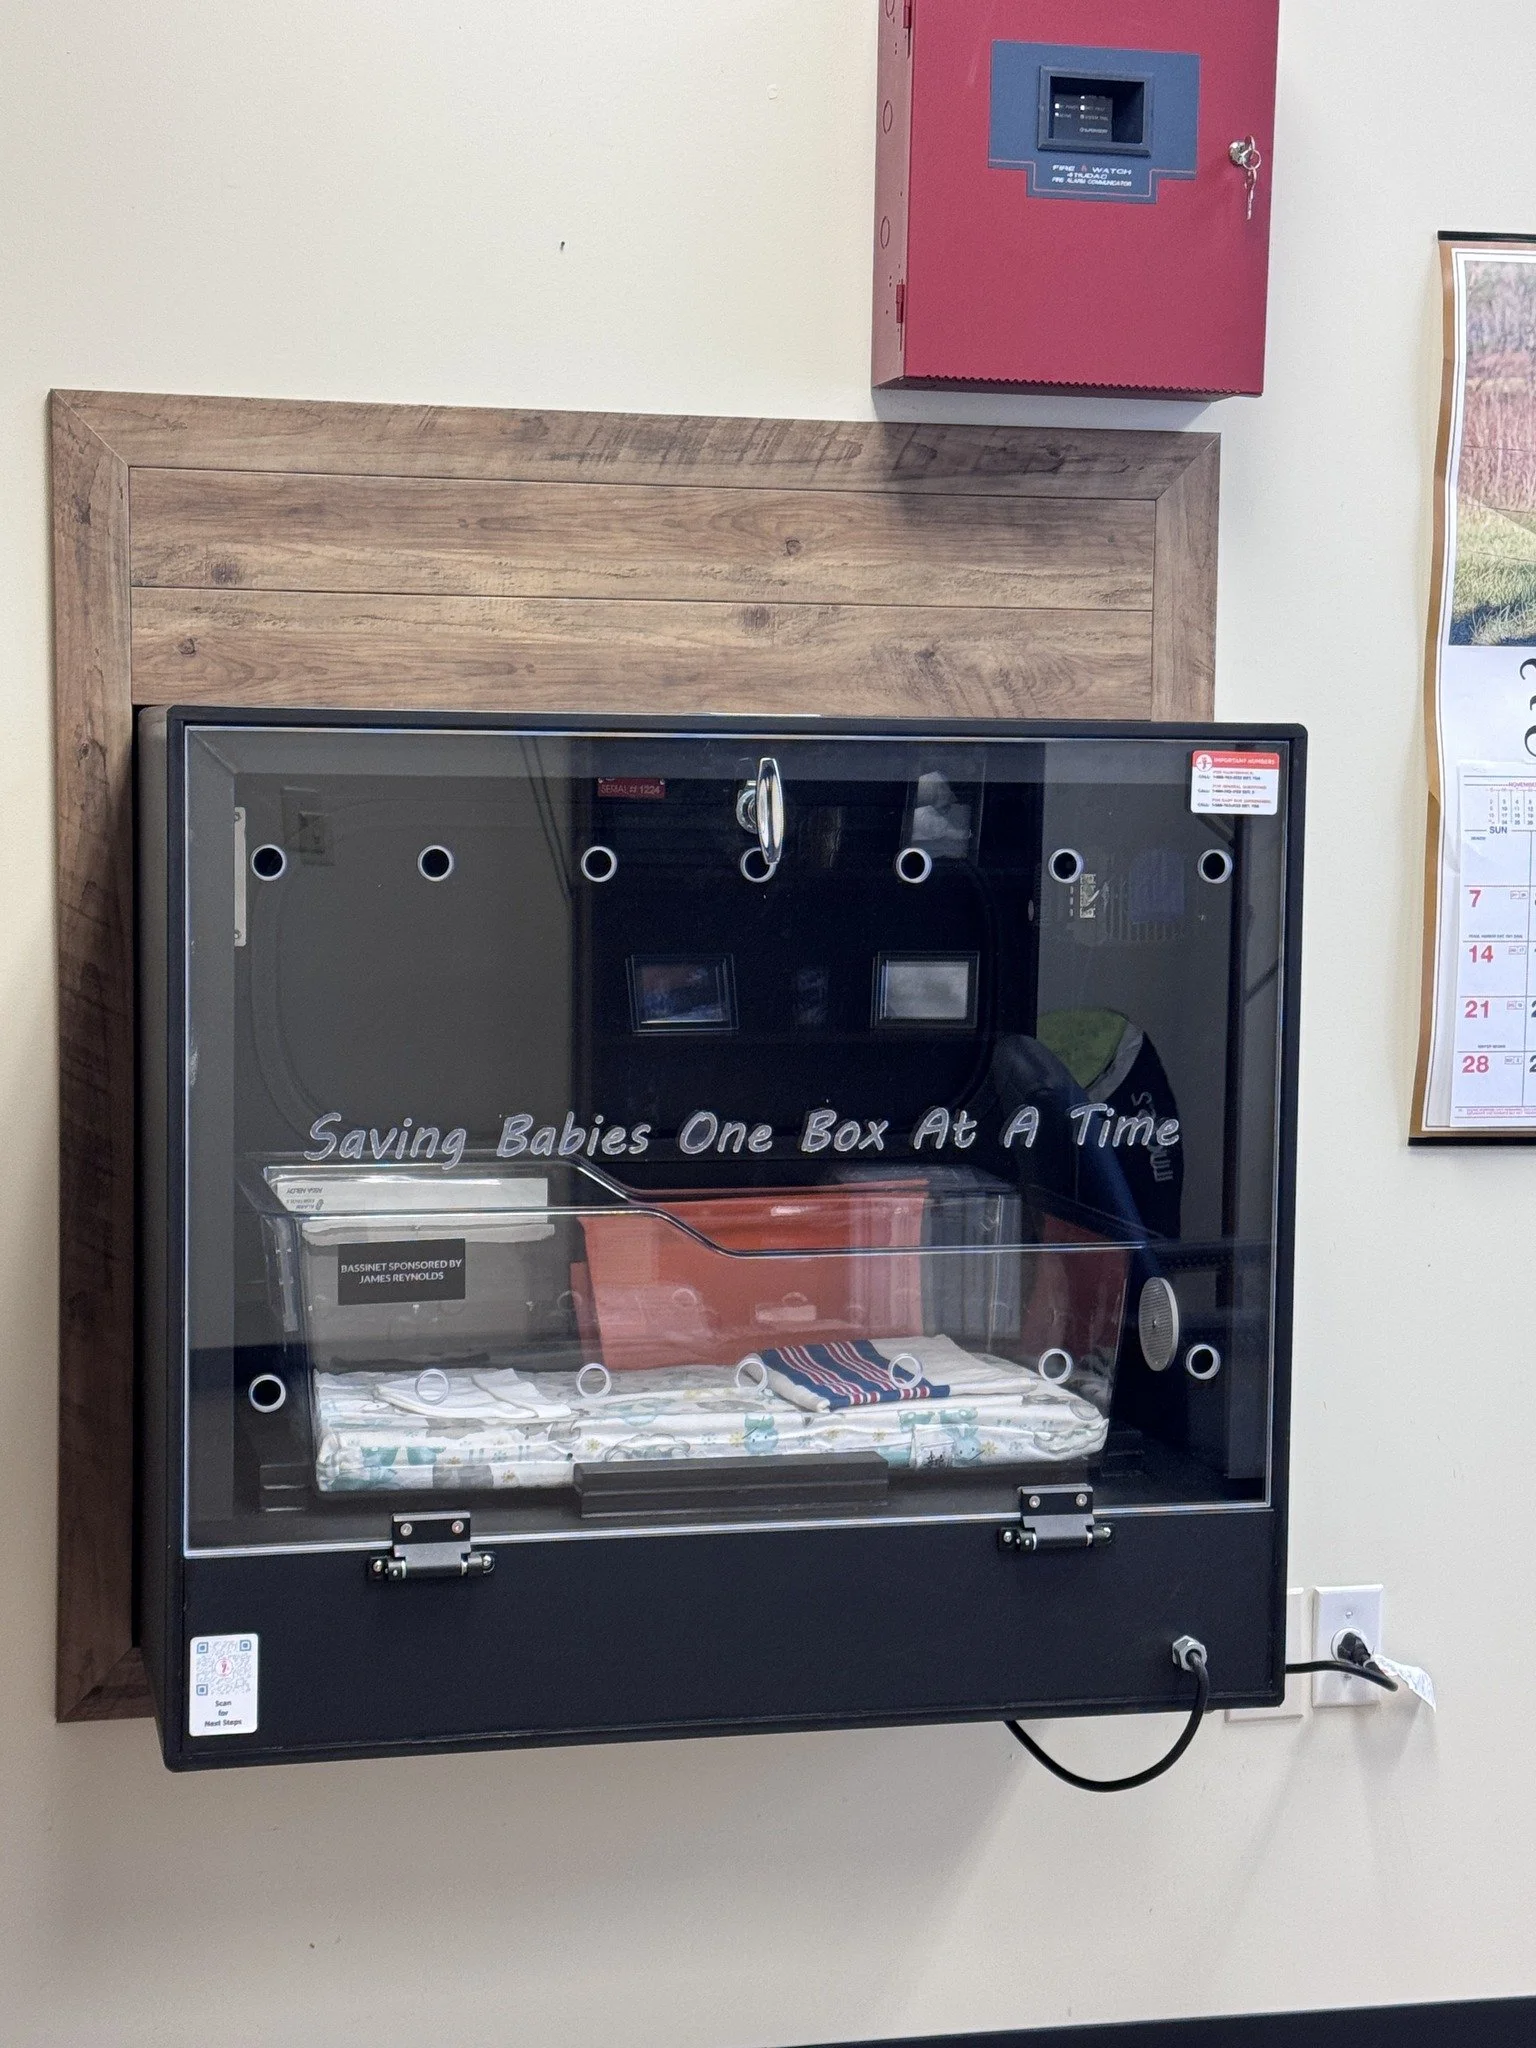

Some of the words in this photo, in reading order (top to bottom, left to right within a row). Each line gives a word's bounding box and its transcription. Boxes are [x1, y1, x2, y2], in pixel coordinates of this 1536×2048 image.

[1052, 164, 1075, 172] FIRE
[1092, 166, 1132, 175] WATCH
[600, 784, 627, 794] SERIAL
[640, 785, 660, 794] 1224
[1489, 826, 1508, 834] SUN
[1468, 889, 1482, 908] 7
[1469, 944, 1493, 963] 14
[1464, 1000, 1489, 1018] 21
[1462, 1055, 1489, 1074] 28
[303, 1112, 467, 1171] Saving
[497, 1111, 652, 1158] Babies
[678, 1110, 773, 1155] One
[800, 1108, 889, 1153] Box
[913, 1107, 977, 1150] At
[1003, 1105, 1040, 1149] A
[1069, 1103, 1180, 1148] Time
[340, 1262, 387, 1273] BASSINET
[388, 1260, 448, 1271] SPONSORED
[449, 1258, 463, 1269] BY
[359, 1274, 391, 1284] JAMES
[392, 1271, 444, 1282] REYNOLDS
[222, 1719, 242, 1727] Steps
